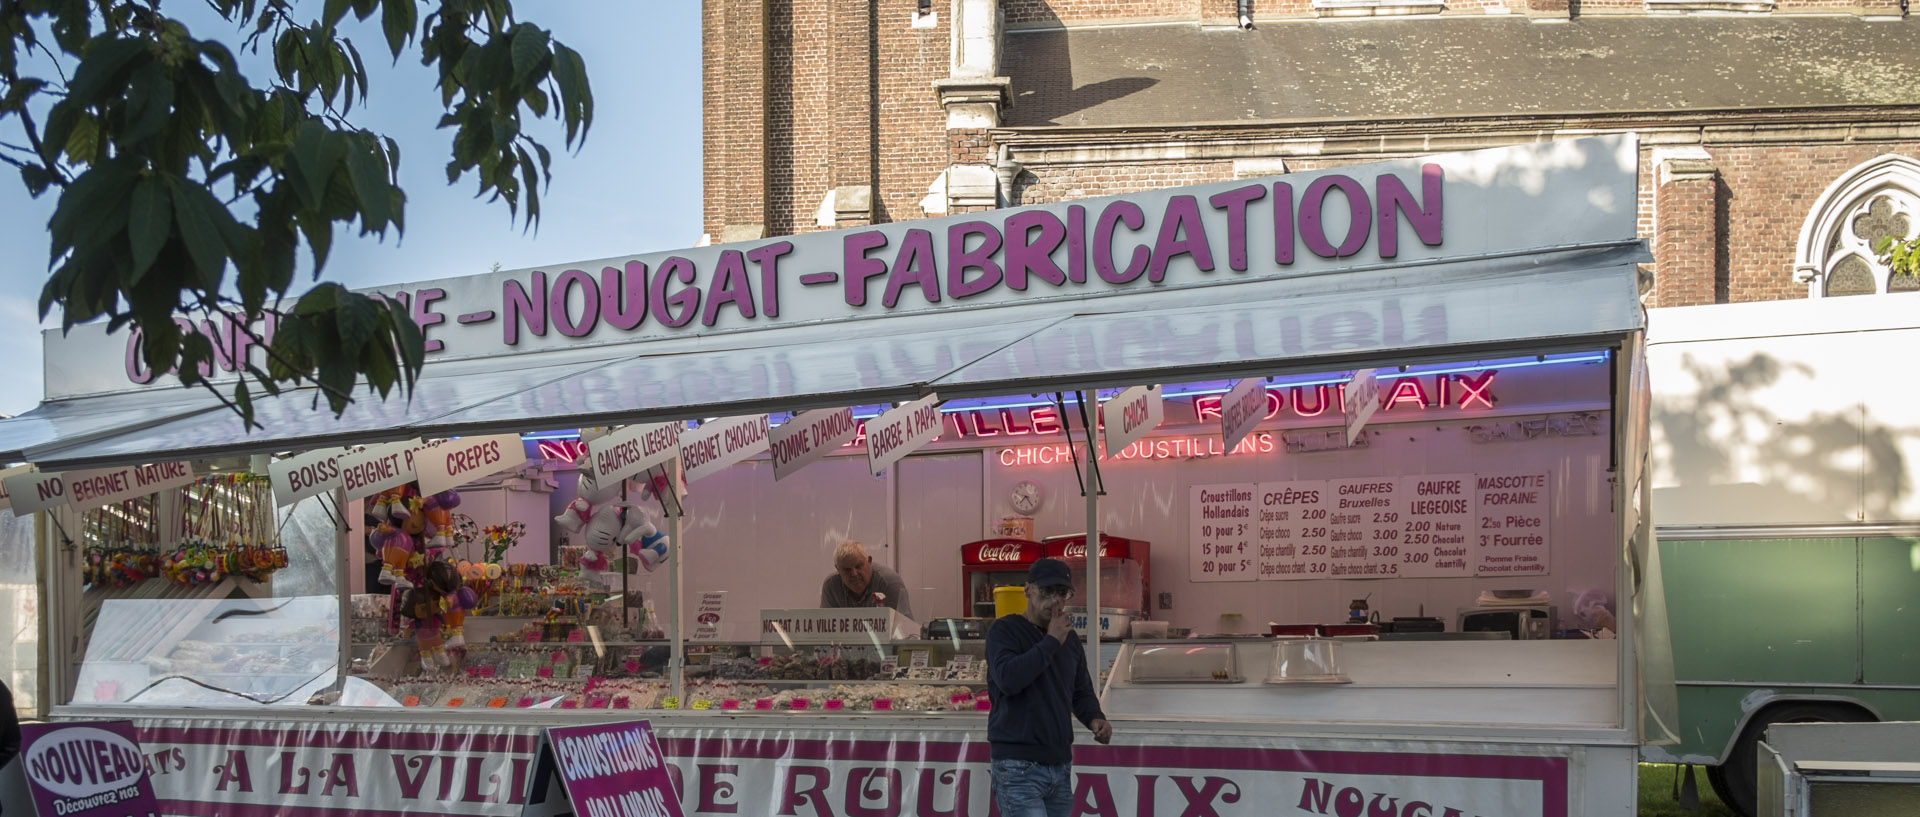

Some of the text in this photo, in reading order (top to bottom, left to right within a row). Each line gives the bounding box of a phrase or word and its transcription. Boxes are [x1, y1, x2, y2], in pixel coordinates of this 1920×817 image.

[503, 241, 794, 345] NOUGAT
[843, 162, 1445, 308] FABRICATION
[1123, 394, 1149, 434] CHICHI
[772, 431, 811, 468] POMME
[812, 406, 855, 449] D'AMOUR
[872, 424, 904, 460] BARBE
[907, 419, 914, 440] A
[914, 405, 938, 434] PAPA
[682, 414, 769, 471] BEIGNET CHOCOLAT
[447, 440, 500, 476] CREPES
[597, 438, 640, 476] GAUFRES
[288, 453, 344, 493] BOISS
[343, 453, 400, 491] BEIGNET
[72, 461, 187, 502] BEIGNET NATURE
[1338, 483, 1393, 495] GAUFRES
[1417, 480, 1461, 495] GAUFRE
[1477, 475, 1545, 490] MASCOTTE
[1200, 488, 1252, 503] Croustillons
[1263, 487, 1320, 506] CRÊPES
[1339, 497, 1391, 509] Bruxelles
[1483, 492, 1539, 505] FORAINE
[1203, 505, 1250, 519] Hollandais
[1301, 509, 1327, 520] 2.00
[1411, 500, 1468, 515] LIEGEOISE
[1330, 513, 1347, 525] Gaufre
[1373, 513, 1399, 523] 2.50
[1405, 521, 1461, 532] 2.00 Nature
[1506, 515, 1541, 528] Pièce
[1202, 525, 1212, 537] 10
[1215, 526, 1234, 540] pour
[1275, 527, 1290, 538] choco
[1301, 527, 1327, 538] 2.50
[1330, 529, 1398, 541] Gaufre choco 3.00
[1404, 533, 1465, 544] 2.50 Chocolat
[1494, 533, 1543, 547] Fourrée
[978, 543, 1022, 561] Coca-Cola
[1202, 543, 1212, 555] 15
[1215, 544, 1233, 558] pour
[1276, 543, 1296, 559] chantilly
[1301, 545, 1327, 555] 2.50
[1331, 545, 1398, 560] Gaufre chantilly 3.00
[1403, 553, 1429, 563] 3.00
[1434, 547, 1466, 557] Chocolat
[1435, 559, 1466, 570] chantilly
[1485, 554, 1538, 563] Pomme Fraise
[1203, 561, 1215, 573] 20
[1218, 562, 1236, 576] pour
[1276, 562, 1291, 574] choco
[1309, 562, 1327, 573] 3.0
[1331, 563, 1347, 575] Gaufre
[1347, 563, 1362, 574] choco
[1380, 564, 1398, 574] 3.5
[1478, 564, 1545, 573] Chocolat chantilly
[795, 619, 801, 633] A
[803, 619, 813, 633] LA
[839, 618, 850, 633] DE
[852, 617, 887, 633] ROUBAIX
[31, 738, 142, 785] NOUVEAU
[558, 728, 659, 782] CROUSTILLONS
[213, 750, 254, 793] A
[277, 751, 360, 798] LA
[53, 785, 140, 816] Découvrez nos
